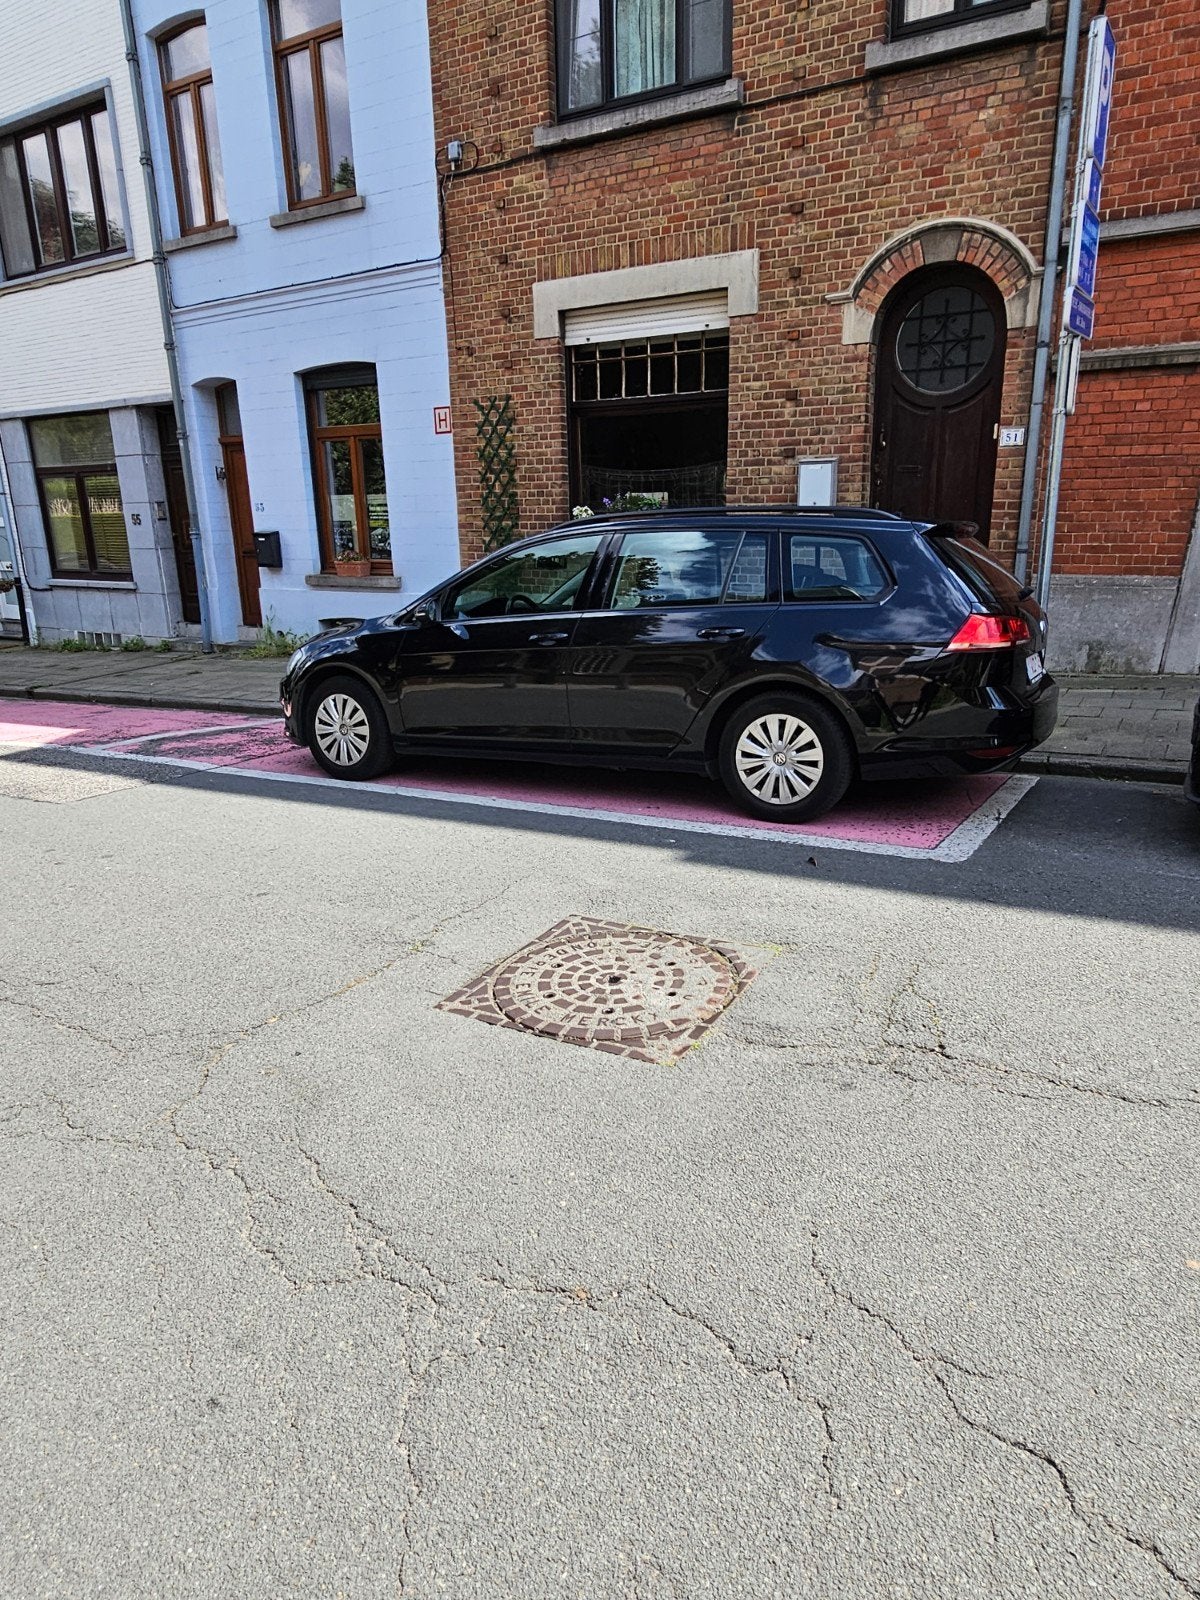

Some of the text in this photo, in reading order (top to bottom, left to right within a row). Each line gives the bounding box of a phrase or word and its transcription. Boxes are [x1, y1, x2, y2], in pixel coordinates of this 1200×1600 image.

[1096, 44, 1111, 139] P
[438, 411, 448, 429] H
[1005, 432, 1018, 443] 51
[131, 514, 142, 526] 55
[520, 942, 612, 977] FONDERIE
[516, 983, 551, 1014] EMILE
